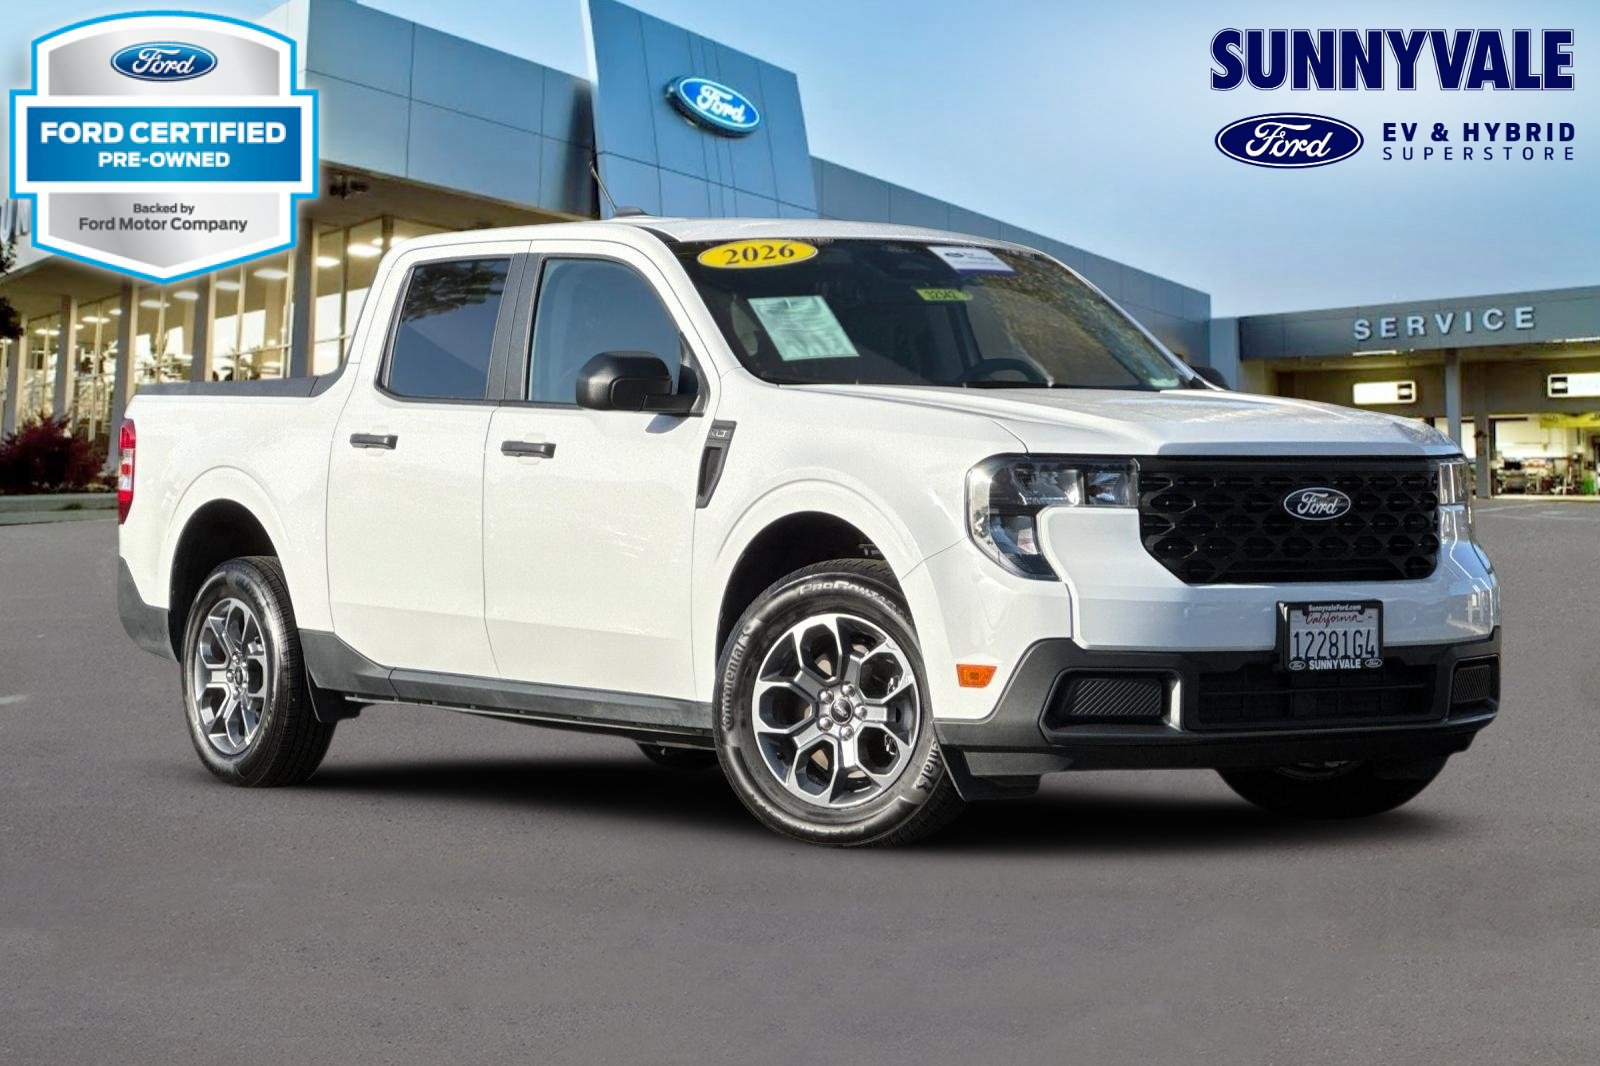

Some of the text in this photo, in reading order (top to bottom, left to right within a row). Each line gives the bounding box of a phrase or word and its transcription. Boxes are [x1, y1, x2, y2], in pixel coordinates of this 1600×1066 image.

[696, 84, 746, 122] Ford
[723, 243, 795, 265] 2026
[1353, 306, 1536, 341] SERVICE
[1297, 491, 1339, 515] Ford
[1305, 612, 1363, 628] California
[1293, 628, 1376, 659] 12281G4
[1309, 658, 1362, 670] SUNNYVALE
